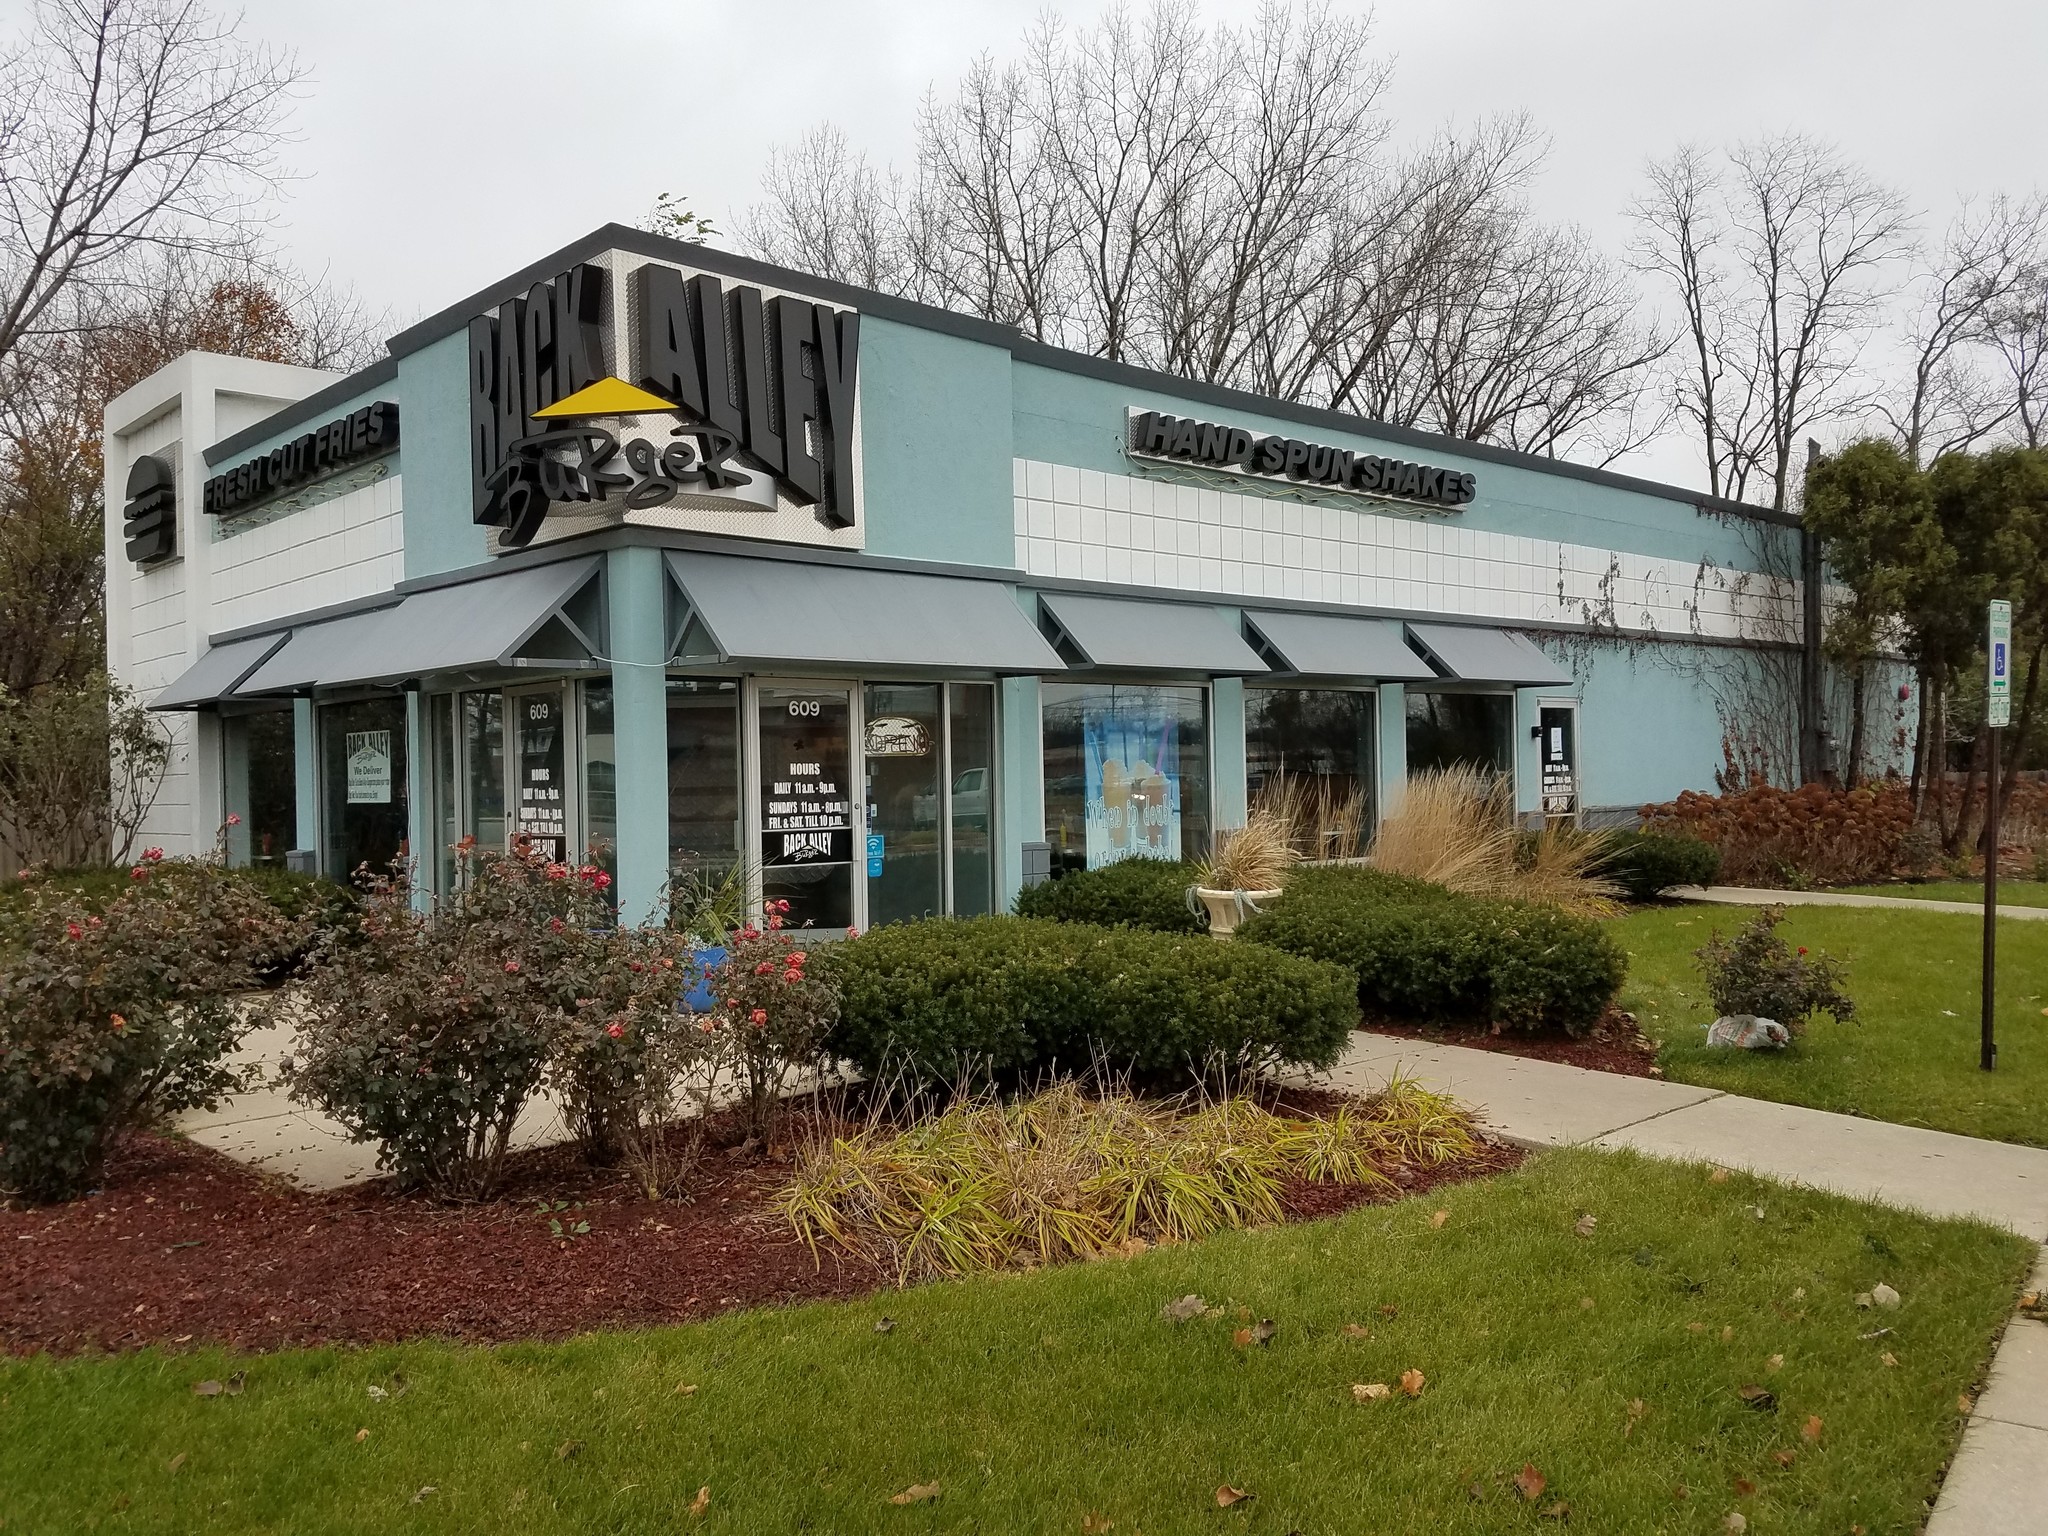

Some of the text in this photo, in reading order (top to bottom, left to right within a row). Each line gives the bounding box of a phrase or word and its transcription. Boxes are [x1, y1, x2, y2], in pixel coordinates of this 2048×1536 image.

[468, 263, 860, 527] BACK ALLEY
[203, 401, 388, 514] FRESH CUT FRIES
[1144, 411, 1476, 504] HAND SPUN SHAKES
[530, 703, 549, 720] 609
[788, 700, 820, 717] 609
[348, 731, 389, 760] BACK ALLEY
[354, 765, 383, 775] We Deliver
[531, 768, 550, 781] HOURS
[790, 763, 820, 775] HOURS
[774, 782, 791, 794] DAILY
[769, 801, 798, 814] SUNDAYS
[1087, 795, 1122, 829] When
[1127, 799, 1139, 828] in
[783, 818, 789, 828] &
[790, 816, 804, 828] SAT.
[783, 832, 832, 858] BACK ALLEY
